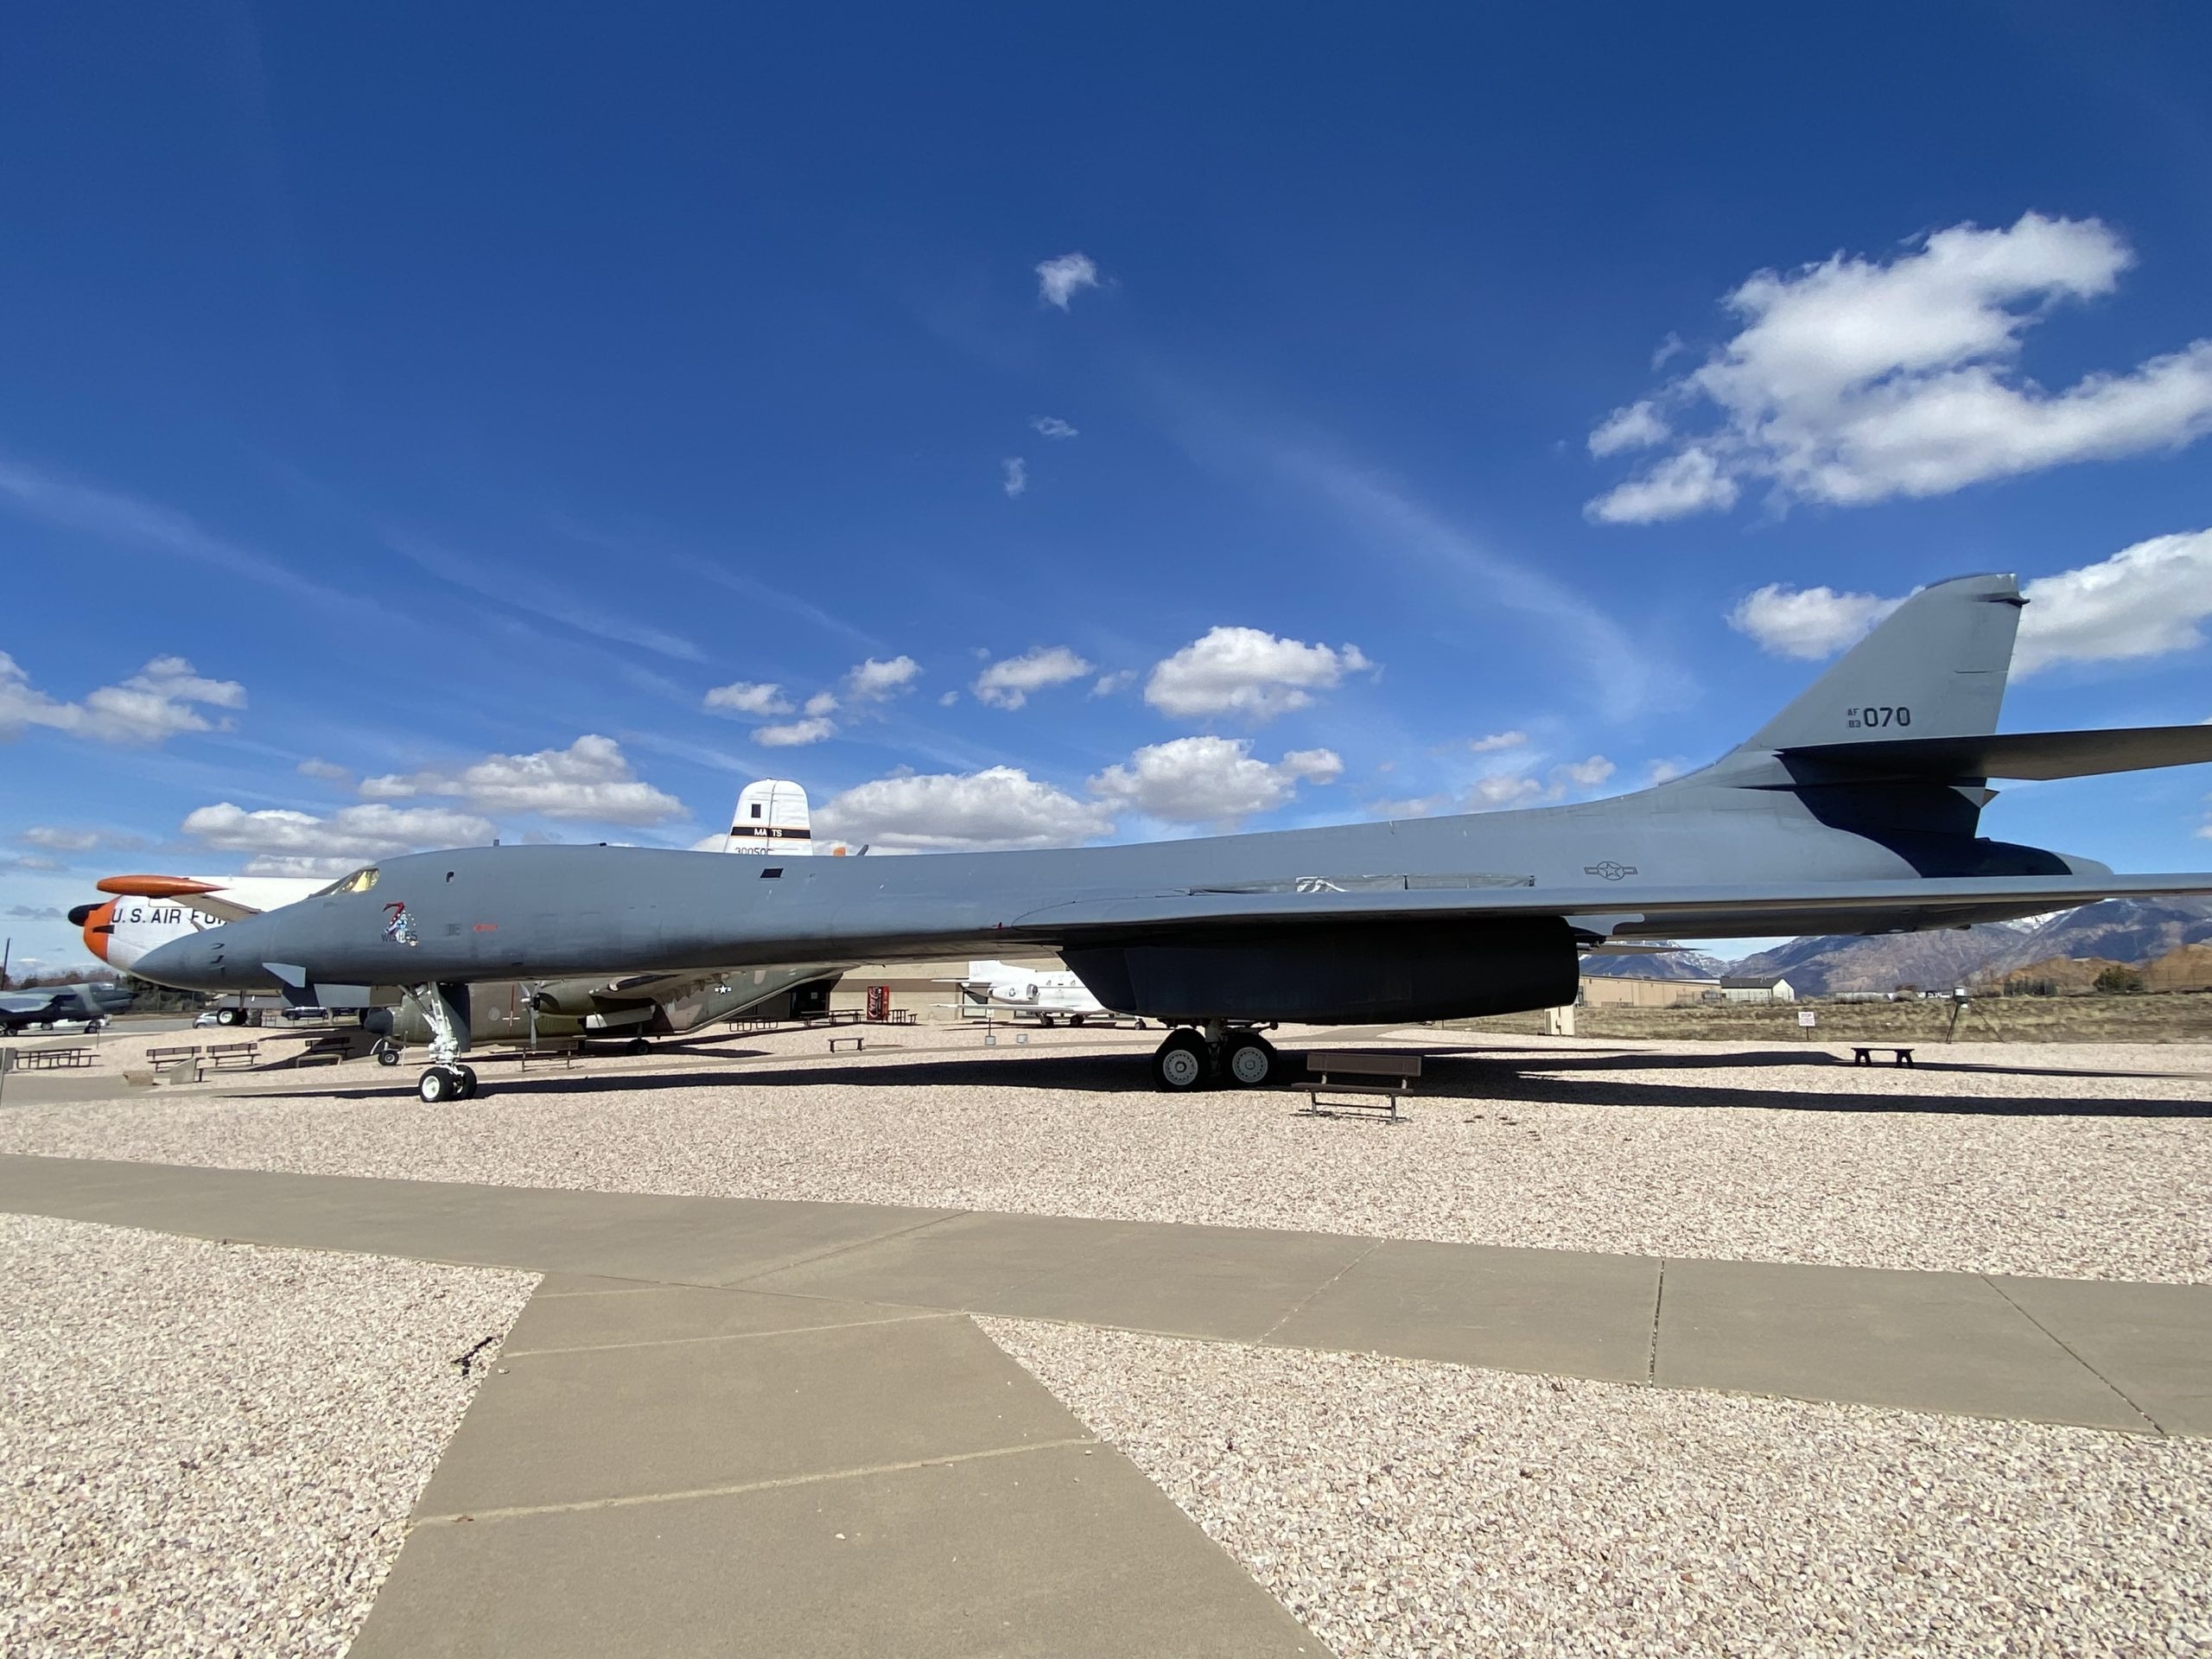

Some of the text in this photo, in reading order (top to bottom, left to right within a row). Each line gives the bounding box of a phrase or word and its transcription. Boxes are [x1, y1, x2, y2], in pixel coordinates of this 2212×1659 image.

[1847, 708, 1859, 716] AF
[1863, 707, 1911, 728] 070
[151, 908, 181, 924] AIR
